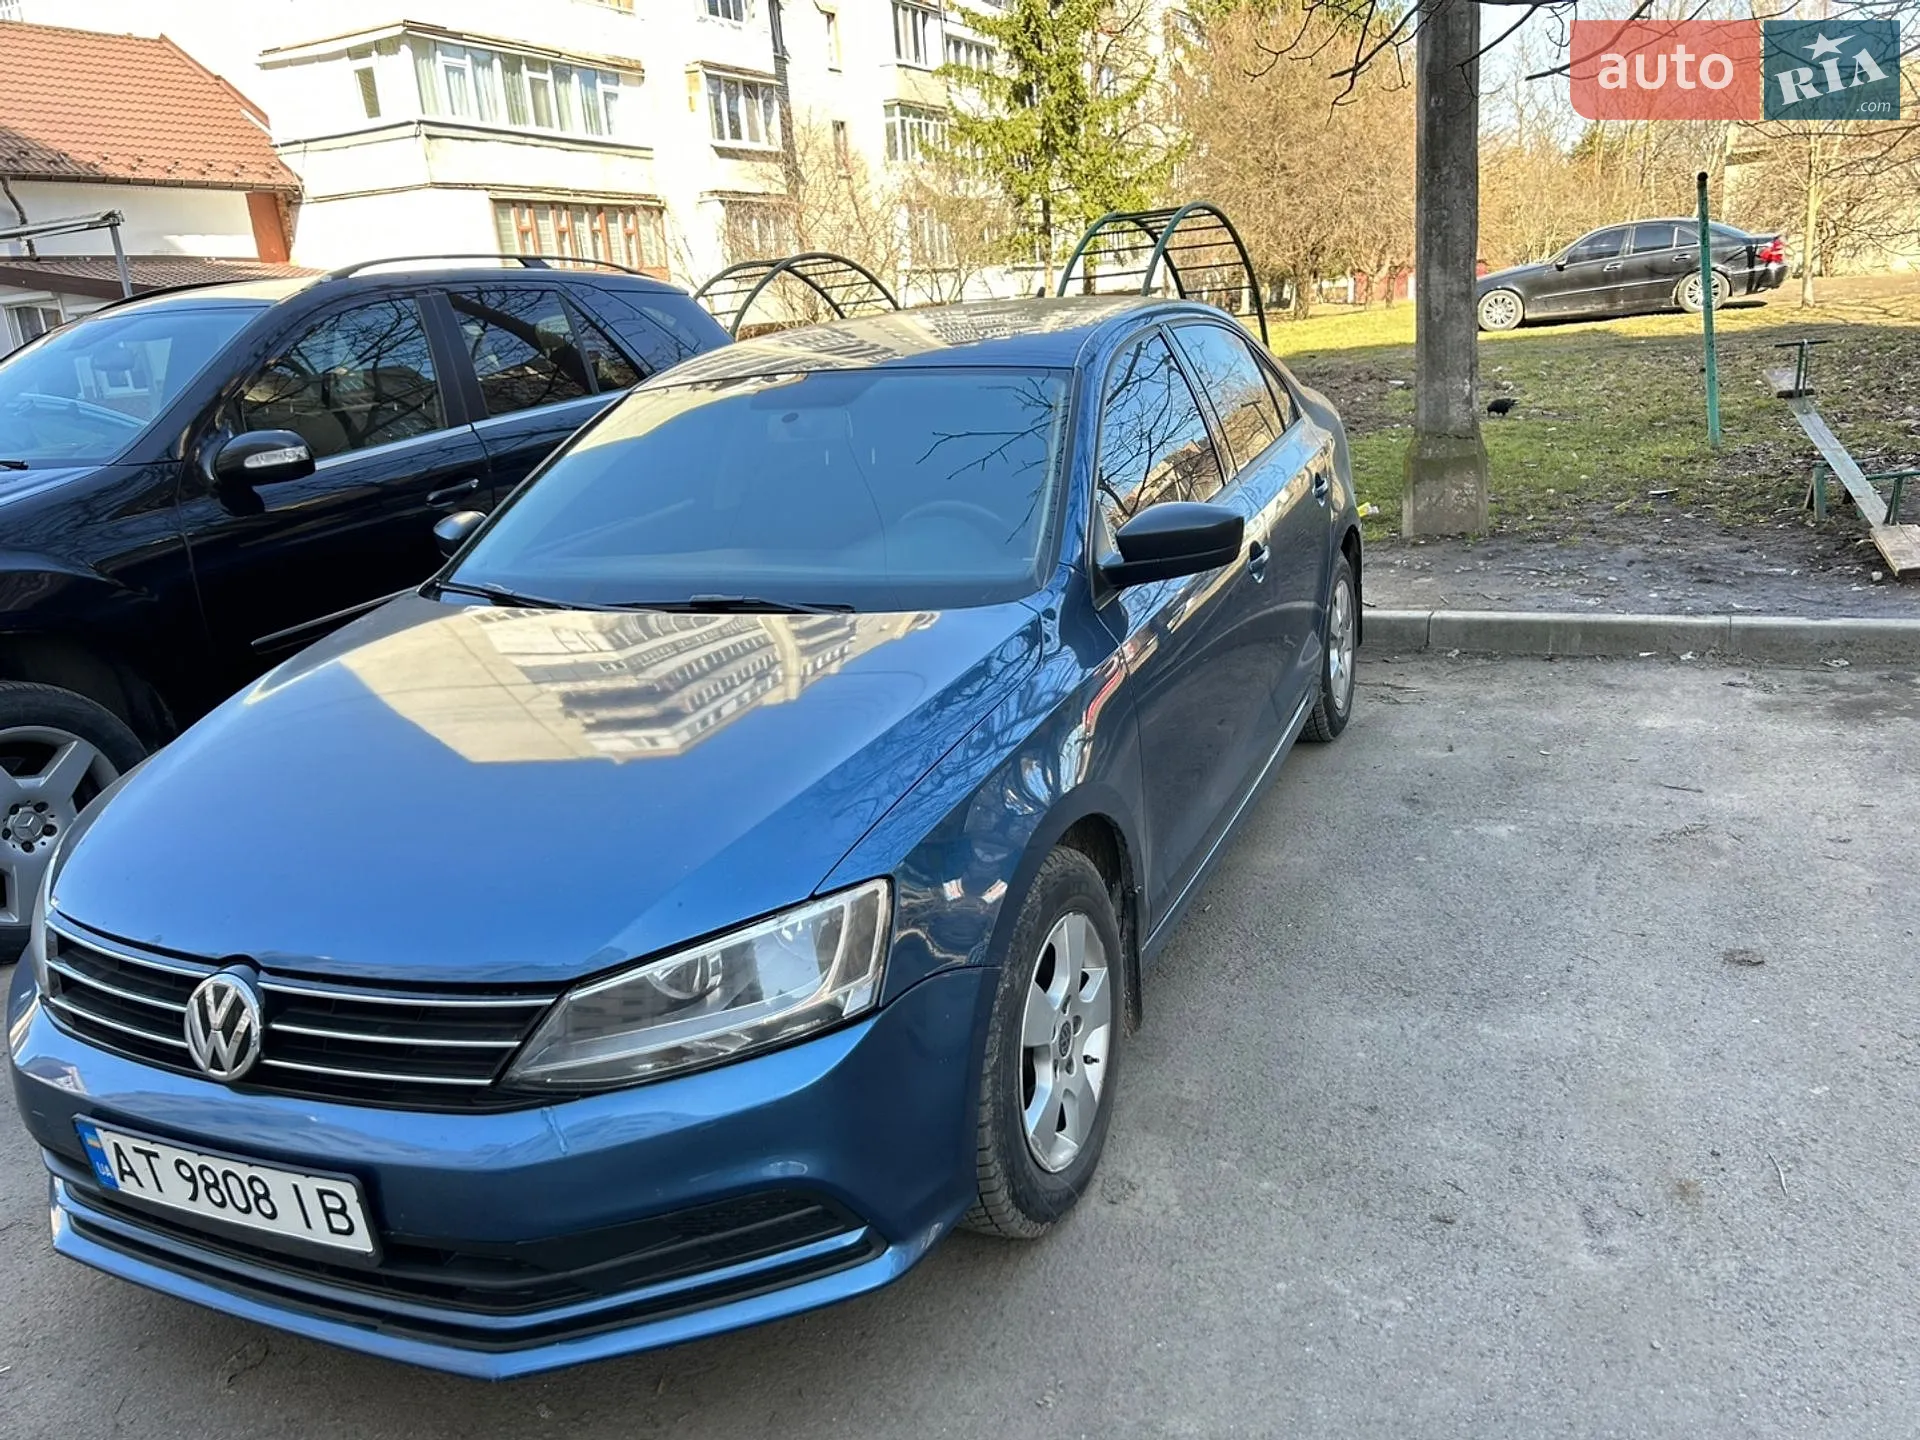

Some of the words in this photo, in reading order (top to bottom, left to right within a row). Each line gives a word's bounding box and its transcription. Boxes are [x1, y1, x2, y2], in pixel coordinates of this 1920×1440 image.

[96, 1161, 115, 1179] UA
[113, 1142, 164, 1193] AT
[174, 1158, 278, 1220] 9808
[292, 1183, 355, 1236] IB
